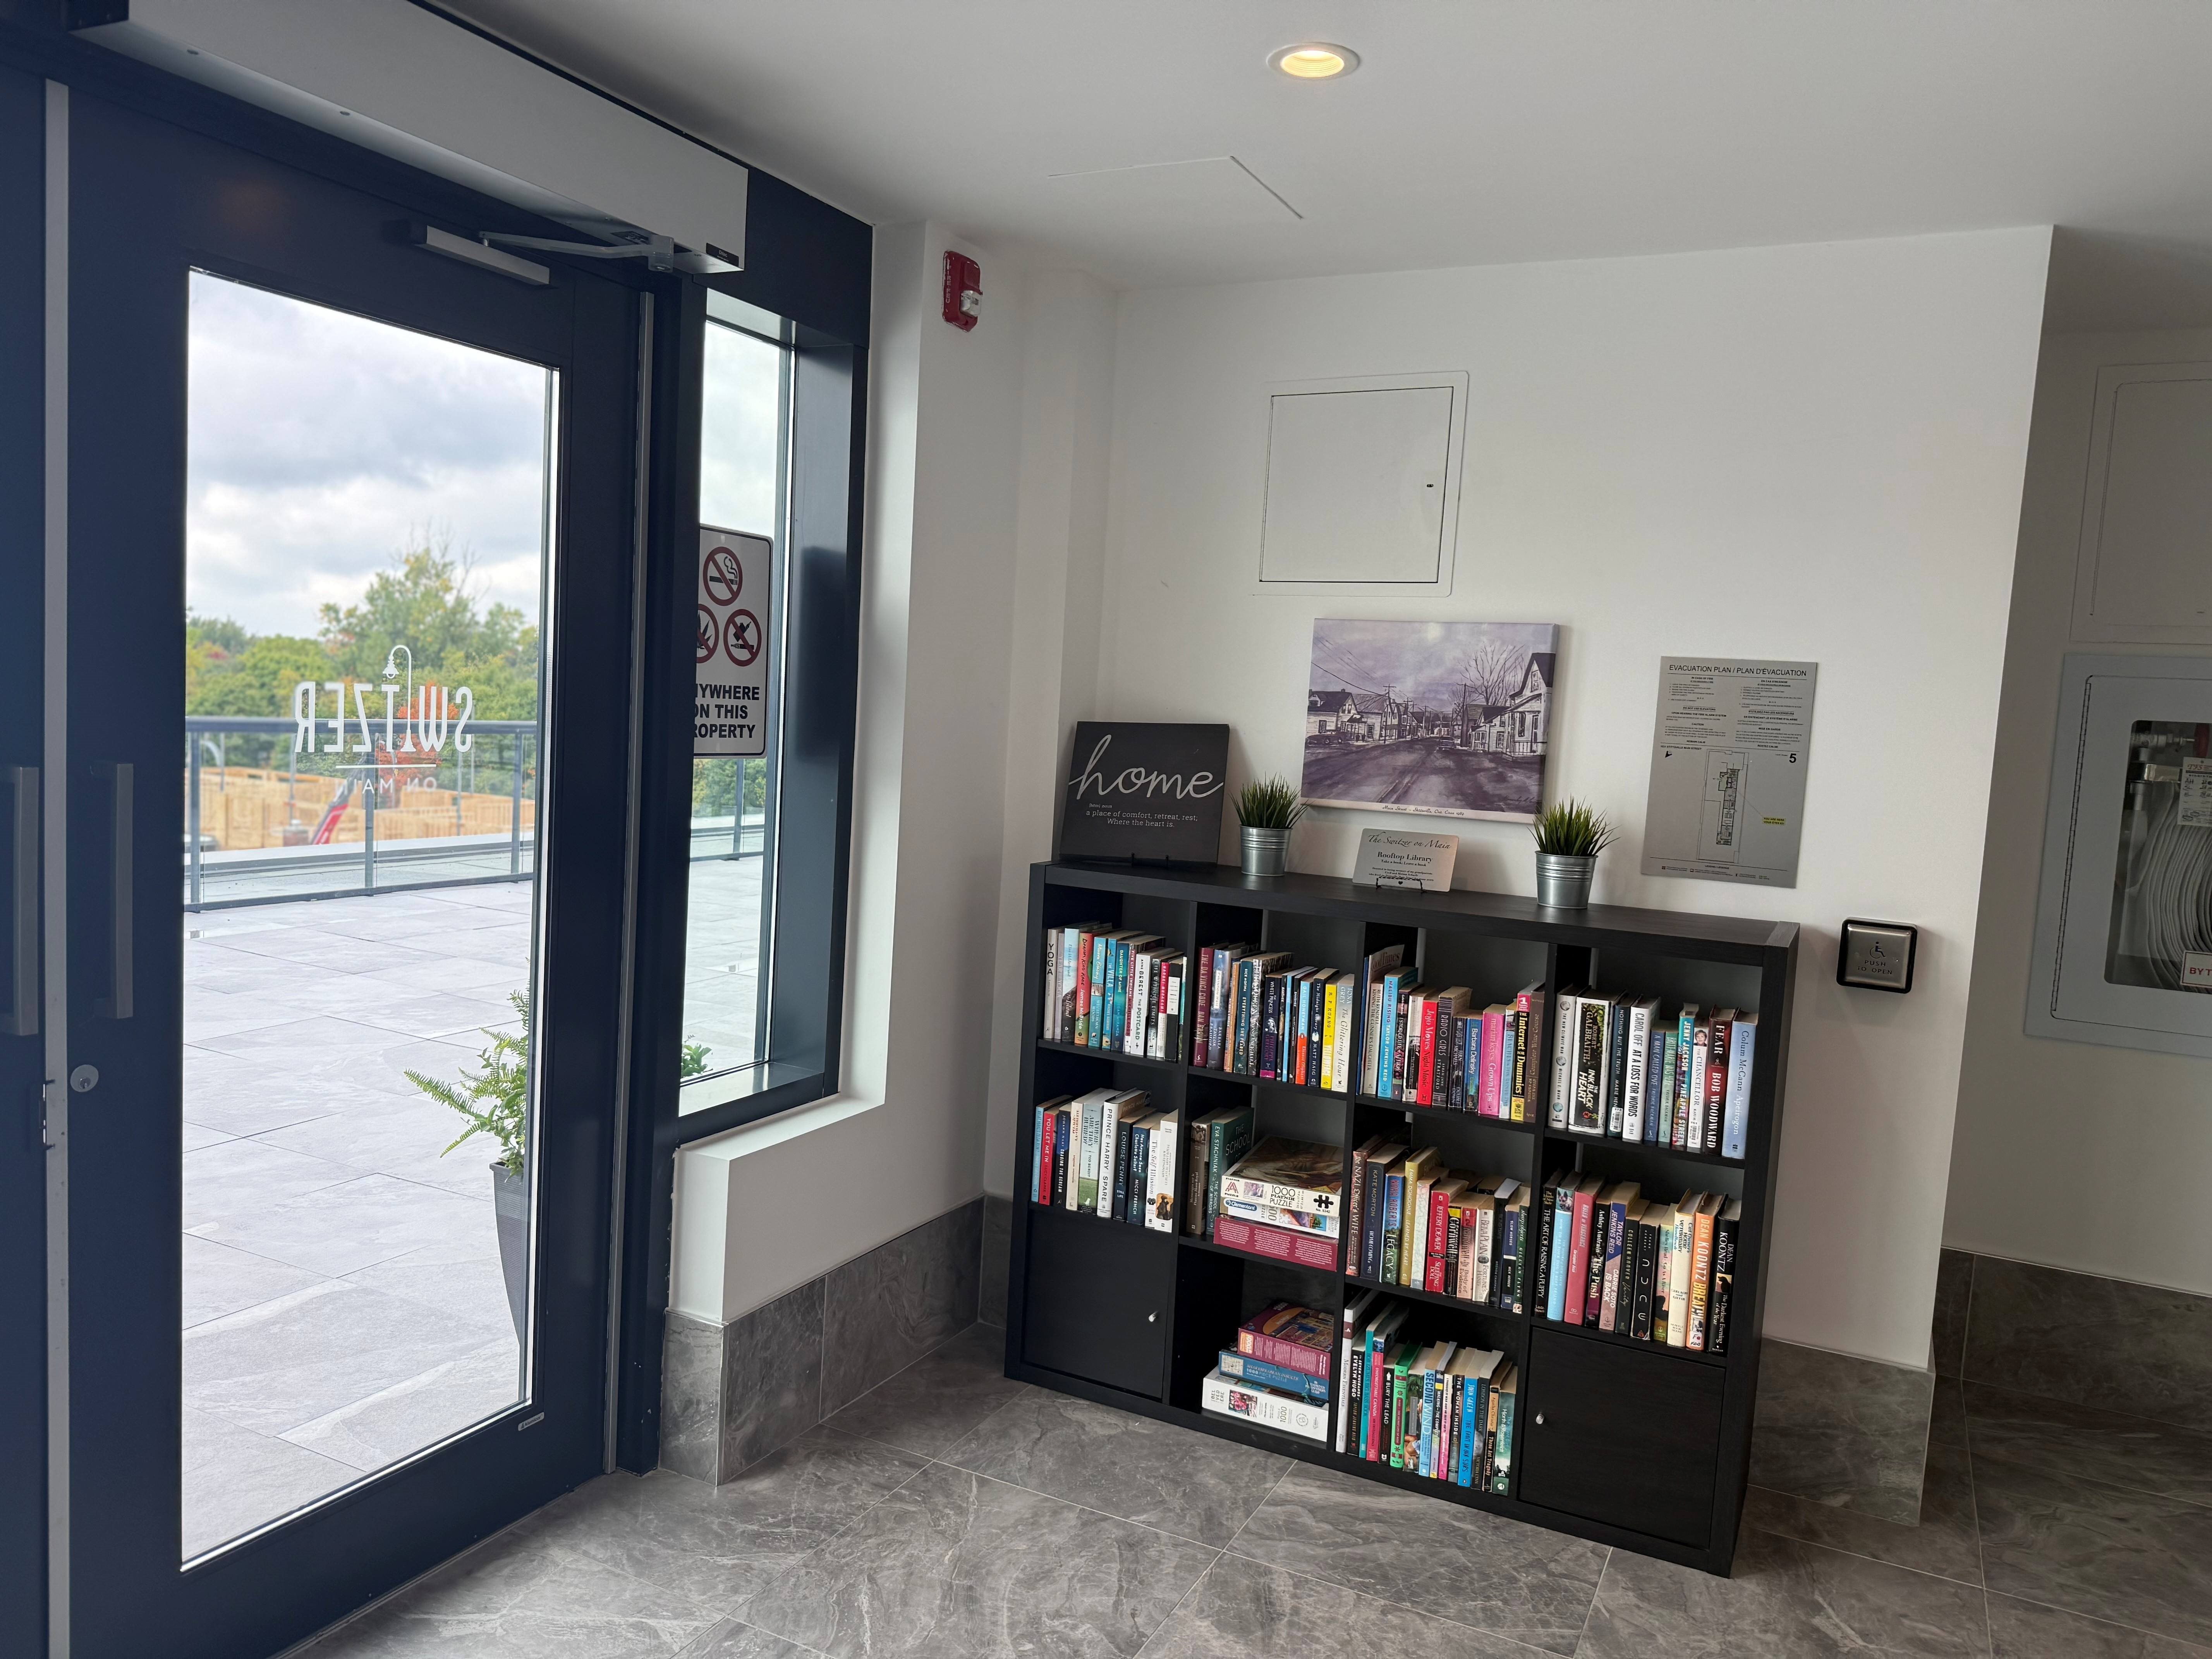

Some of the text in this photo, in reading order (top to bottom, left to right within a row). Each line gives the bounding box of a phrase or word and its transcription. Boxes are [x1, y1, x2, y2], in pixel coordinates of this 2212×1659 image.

[1756, 668, 1807, 676] D'ÉVACUATION
[715, 704, 748, 719] THIS
[1069, 734, 1224, 800] home
[1789, 753, 1797, 763] 5
[1369, 831, 1386, 843] The
[1383, 836, 1412, 847] Switzer
[1425, 840, 1451, 848] Main
[1377, 852, 1432, 863] Rooftop Library
[1336, 1019, 1348, 1056] Glittering
[1438, 1015, 1448, 1056] RADIO GIRLS
[1518, 1017, 1527, 1050] Internet
[1584, 1012, 1593, 1061] GALBRAITH
[1468, 1051, 1477, 1074] Delinsky
[1628, 1013, 1644, 1118] CAROL OFF AT LOSS FOR WORDS
[1681, 1042, 1690, 1071] JACKSON
[1515, 1056, 1525, 1095] Dummies
[1578, 1071, 1588, 1104] HEART
[1693, 1056, 1702, 1106] CHANCELLOR
[1707, 1025, 1725, 1148] FEAR BOB WOODWARD
[1731, 1030, 1750, 1135] Colum McCann Apeirogon
[1585, 1083, 1594, 1109] BLACK
[1679, 1084, 1687, 1119] PINEAPPLE
[1235, 1123, 1244, 1135] THE
[1677, 1119, 1686, 1146] STREET
[1225, 1133, 1250, 1156] SCHOOL
[1231, 1201, 1255, 1210] Clementoni
[1269, 1197, 1293, 1207] PUZZLE
[1272, 1185, 1295, 1197] 1000
[1351, 1166, 1362, 1235] NAZI WIFE
[1388, 1179, 1398, 1227] NORA ROBERTS
[1435, 1205, 1443, 1227] JEFFERY
[1610, 1209, 1618, 1237] JENKINS
[1542, 1235, 1549, 1245] OF
[1615, 1221, 1623, 1246] TAYLOR
[1385, 1233, 1397, 1270] LEGACY
[1695, 1219, 1710, 1281] DEAN KOONTZ
[1717, 1232, 1728, 1272] KOONTZ
[1590, 1257, 1603, 1298] The Push
[1603, 1281, 1611, 1303] BACK
